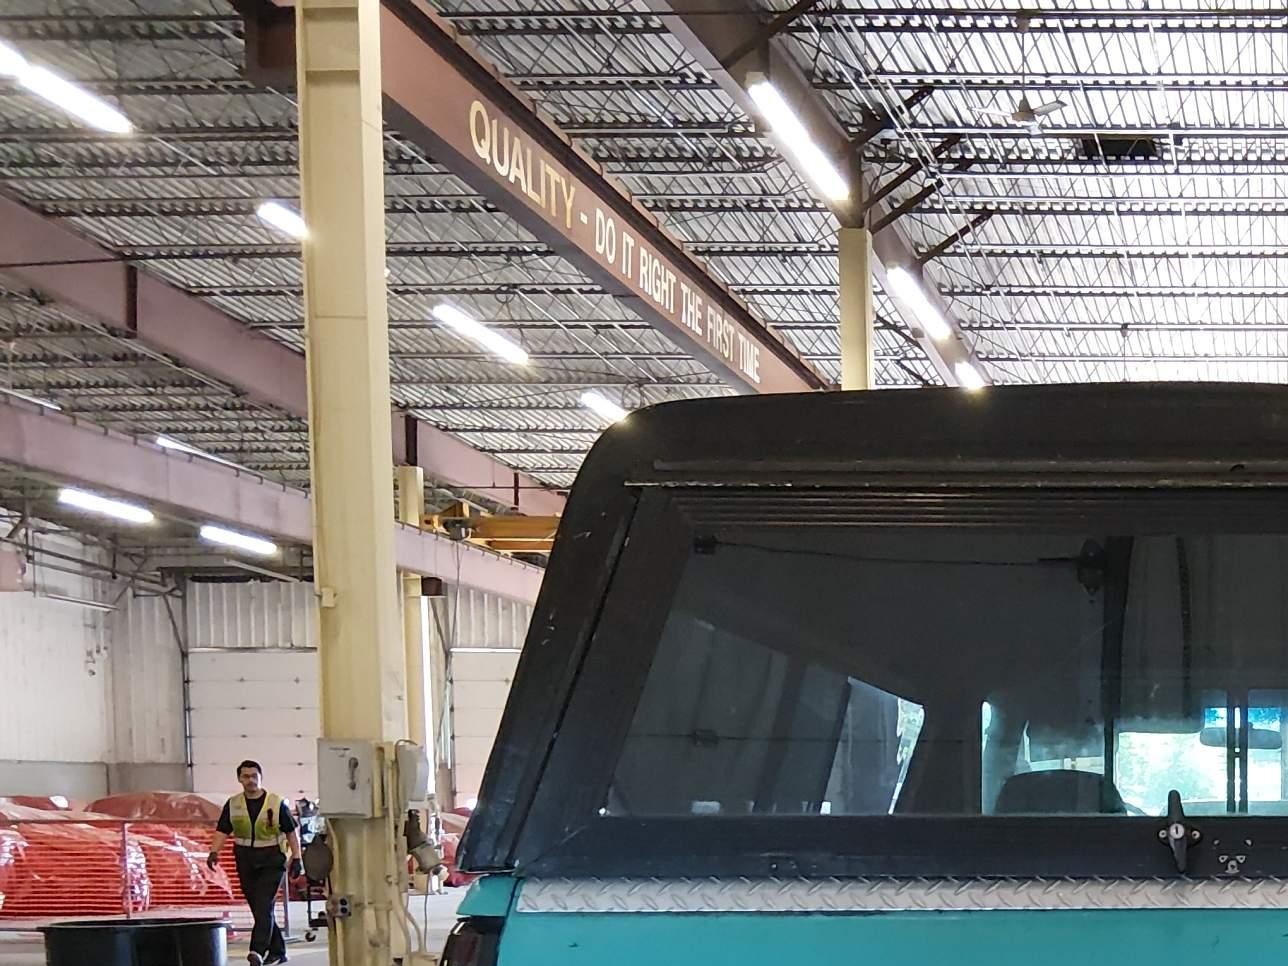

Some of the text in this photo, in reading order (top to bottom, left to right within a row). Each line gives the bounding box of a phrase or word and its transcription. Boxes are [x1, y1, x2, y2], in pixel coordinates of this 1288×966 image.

[469, 100, 576, 229] QUALITY
[595, 208, 616, 264] DO
[622, 231, 634, 279] IT
[639, 247, 677, 314] RIGHT
[680, 282, 703, 336] THE
[707, 305, 735, 362] FIRST
[738, 331, 760, 384] TIME
